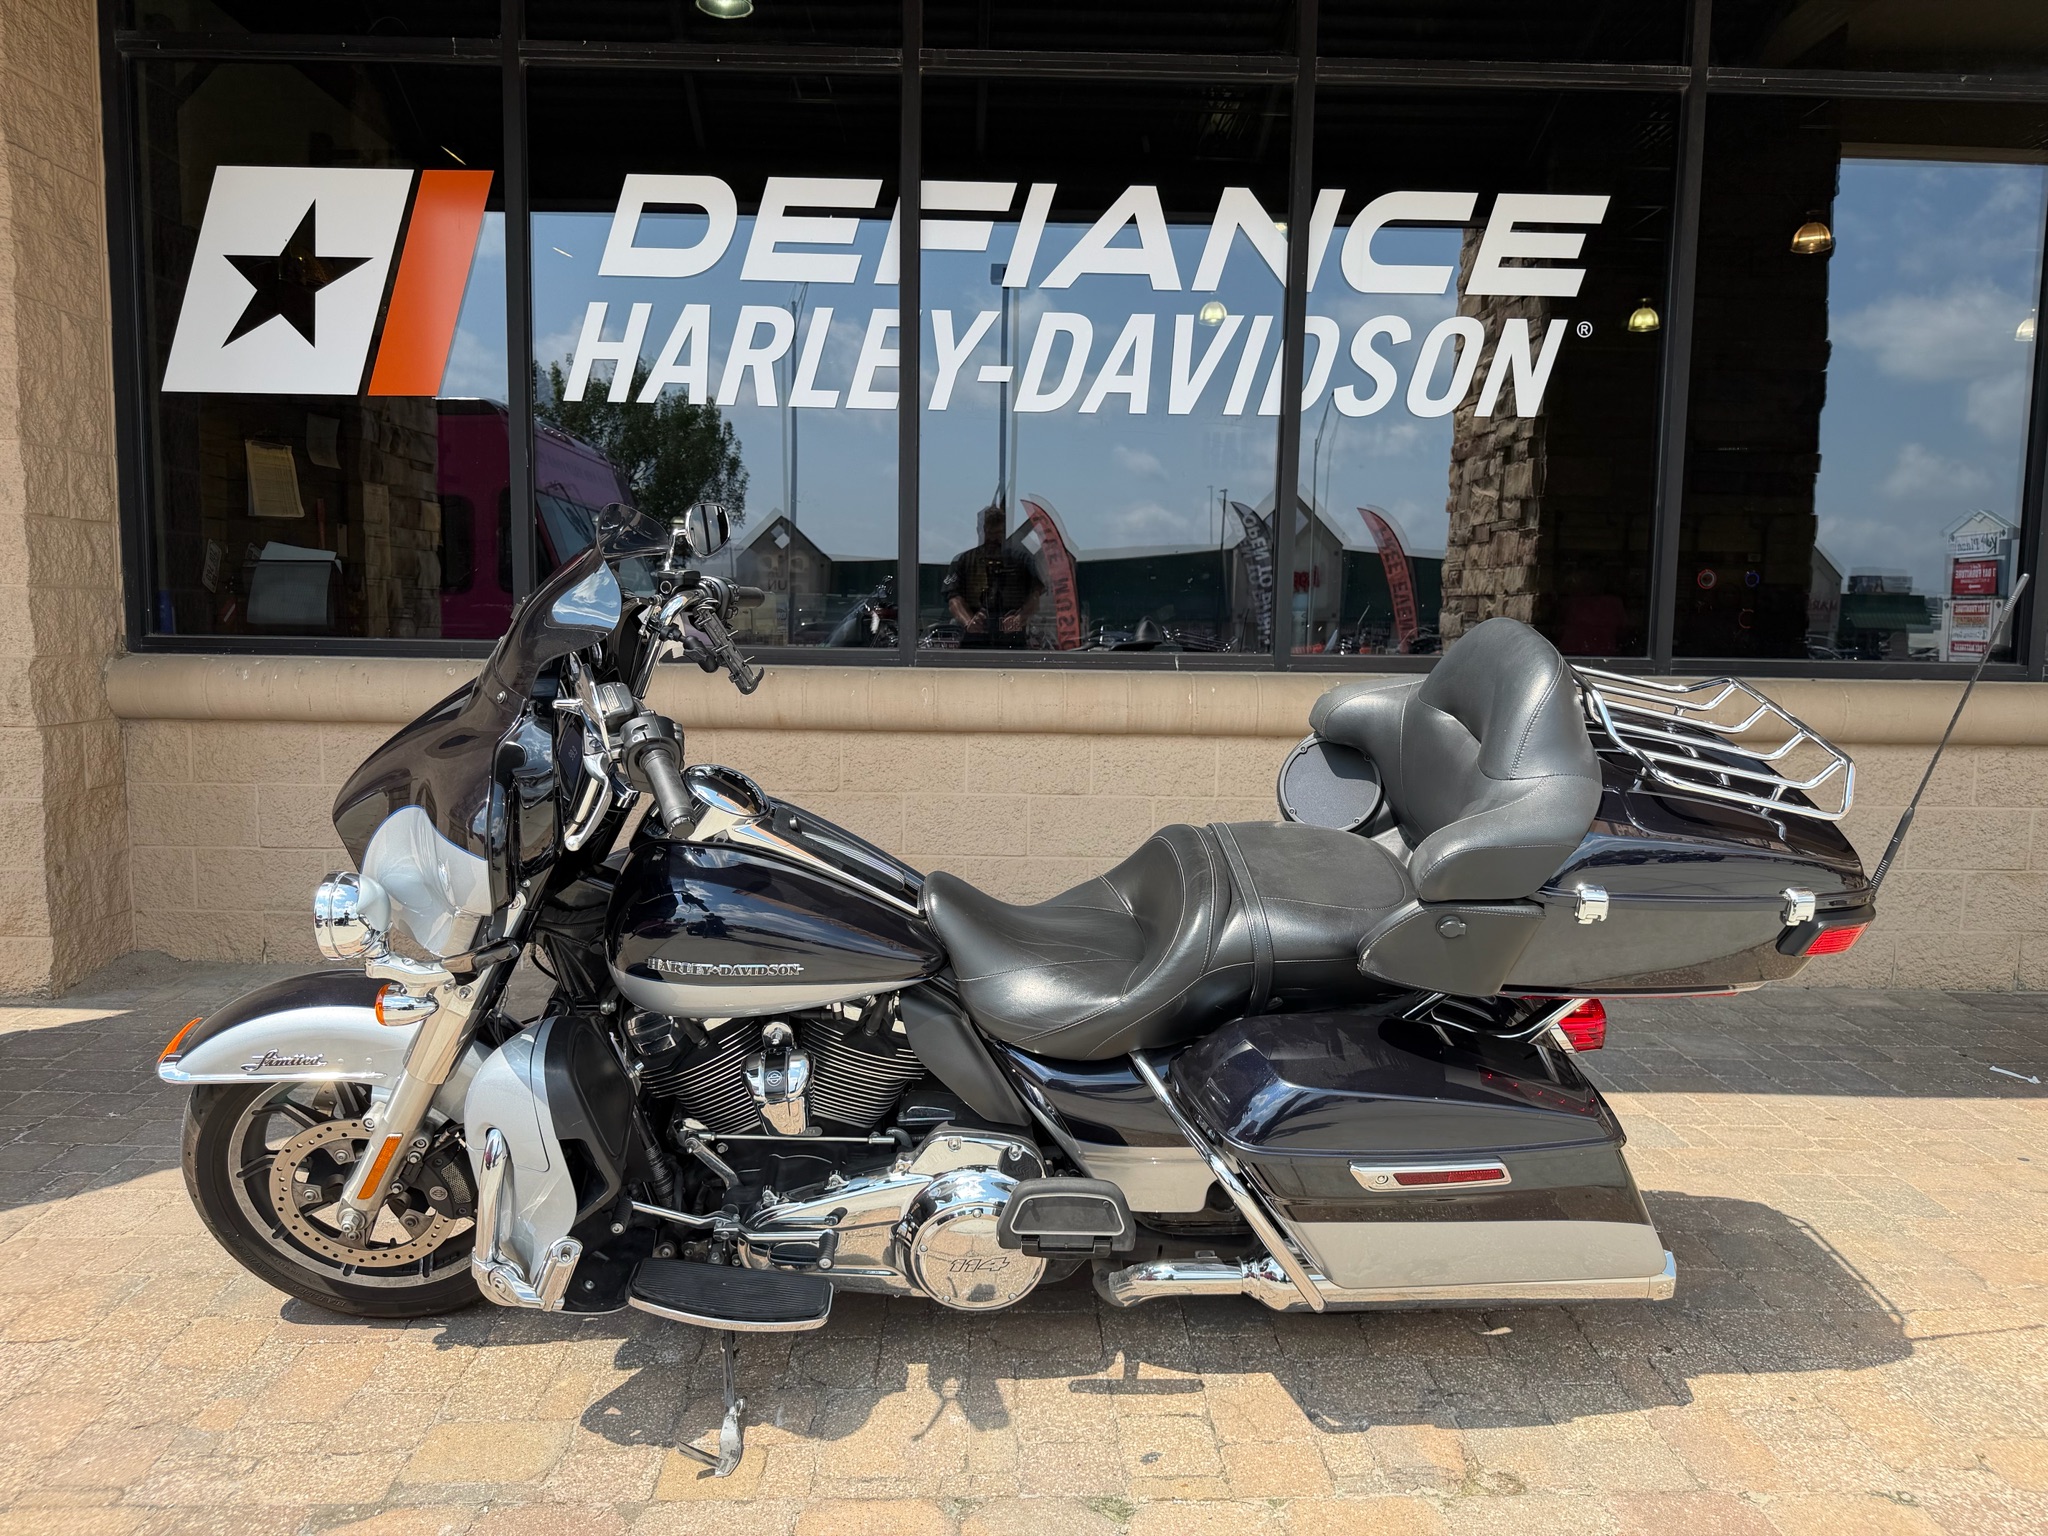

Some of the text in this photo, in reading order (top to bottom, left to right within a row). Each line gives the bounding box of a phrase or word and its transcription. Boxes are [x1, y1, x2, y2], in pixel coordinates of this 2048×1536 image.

[598, 173, 1611, 297] DEFIANCE
[563, 302, 1569, 418] HARLEY-DAVIDSON
[241, 1048, 328, 1072] Limited
[949, 1256, 1011, 1273] 114
